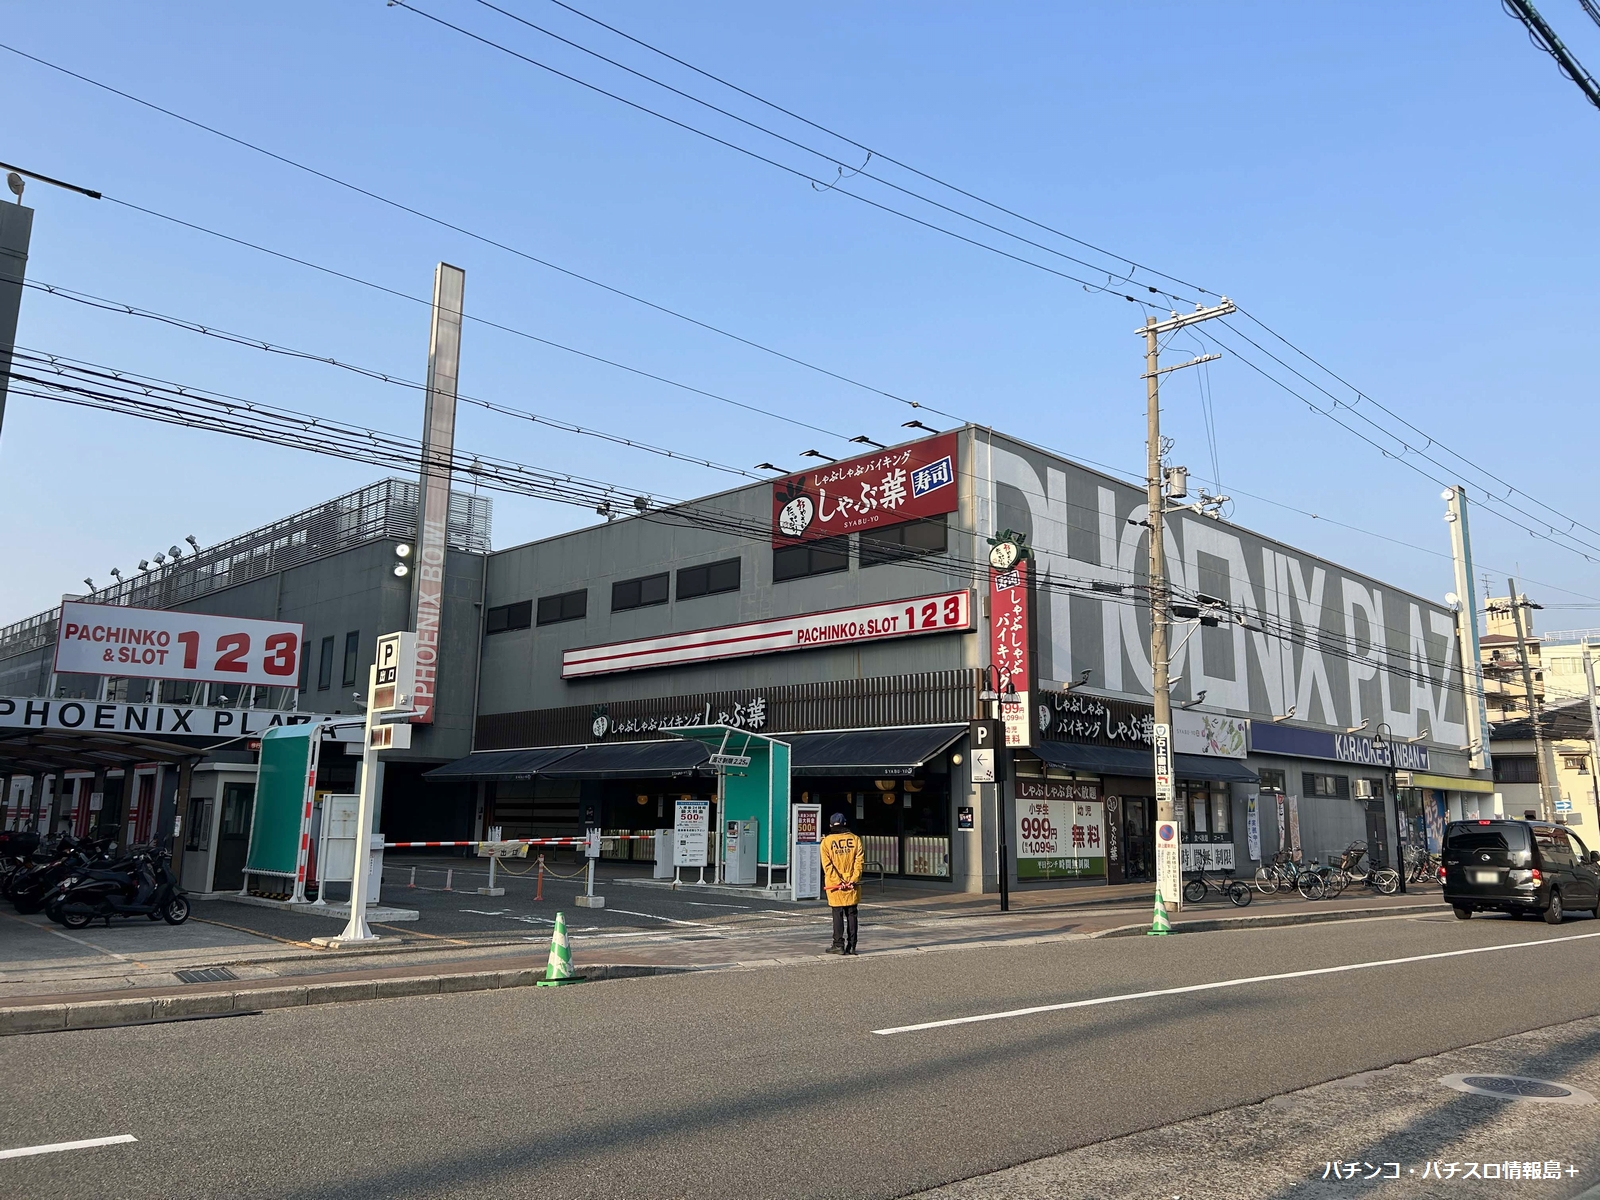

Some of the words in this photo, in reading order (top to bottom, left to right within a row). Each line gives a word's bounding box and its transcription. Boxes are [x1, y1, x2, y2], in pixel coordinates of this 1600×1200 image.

[814, 450, 911, 487] しゃぶしゃぶバイキング
[915, 461, 948, 492] 寿司
[818, 468, 907, 522] しゃぶ葉
[843, 515, 880, 529] SYABU-YO
[420, 514, 447, 583] BOWL
[975, 442, 1339, 727] PHOENIX
[797, 621, 857, 644] PACHINKO
[858, 623, 866, 636] &
[867, 616, 899, 634] SLOT
[905, 595, 960, 630] 123
[1010, 589, 1024, 675] しゃぶしゃぶ
[65, 623, 171, 647] PACHINKO
[414, 589, 441, 699] PHOENIX
[102, 648, 115, 662] &
[117, 646, 169, 666] SLOT
[177, 630, 298, 677] 123
[385, 644, 394, 666] P
[996, 612, 1010, 690] バイキング
[0, 700, 194, 733] PHOENIX
[611, 712, 702, 734] しゃぶしゃぶバイキング
[704, 697, 766, 730] しゃぶ葉
[1054, 694, 1104, 716] しゃぶしゃぶ
[977, 726, 988, 745] P
[1057, 719, 1102, 738] バイキング
[1106, 708, 1155, 746] しゃぶ葉
[1334, 734, 1383, 764] KARAOKE
[1021, 783, 1097, 799] しゃぶしゃぶ食べ放題
[1029, 803, 1049, 815] 小学生
[1077, 805, 1092, 817] 幼児
[1021, 817, 1058, 840] 999円
[1071, 824, 1101, 849] 無料
[831, 839, 855, 850] ACE
